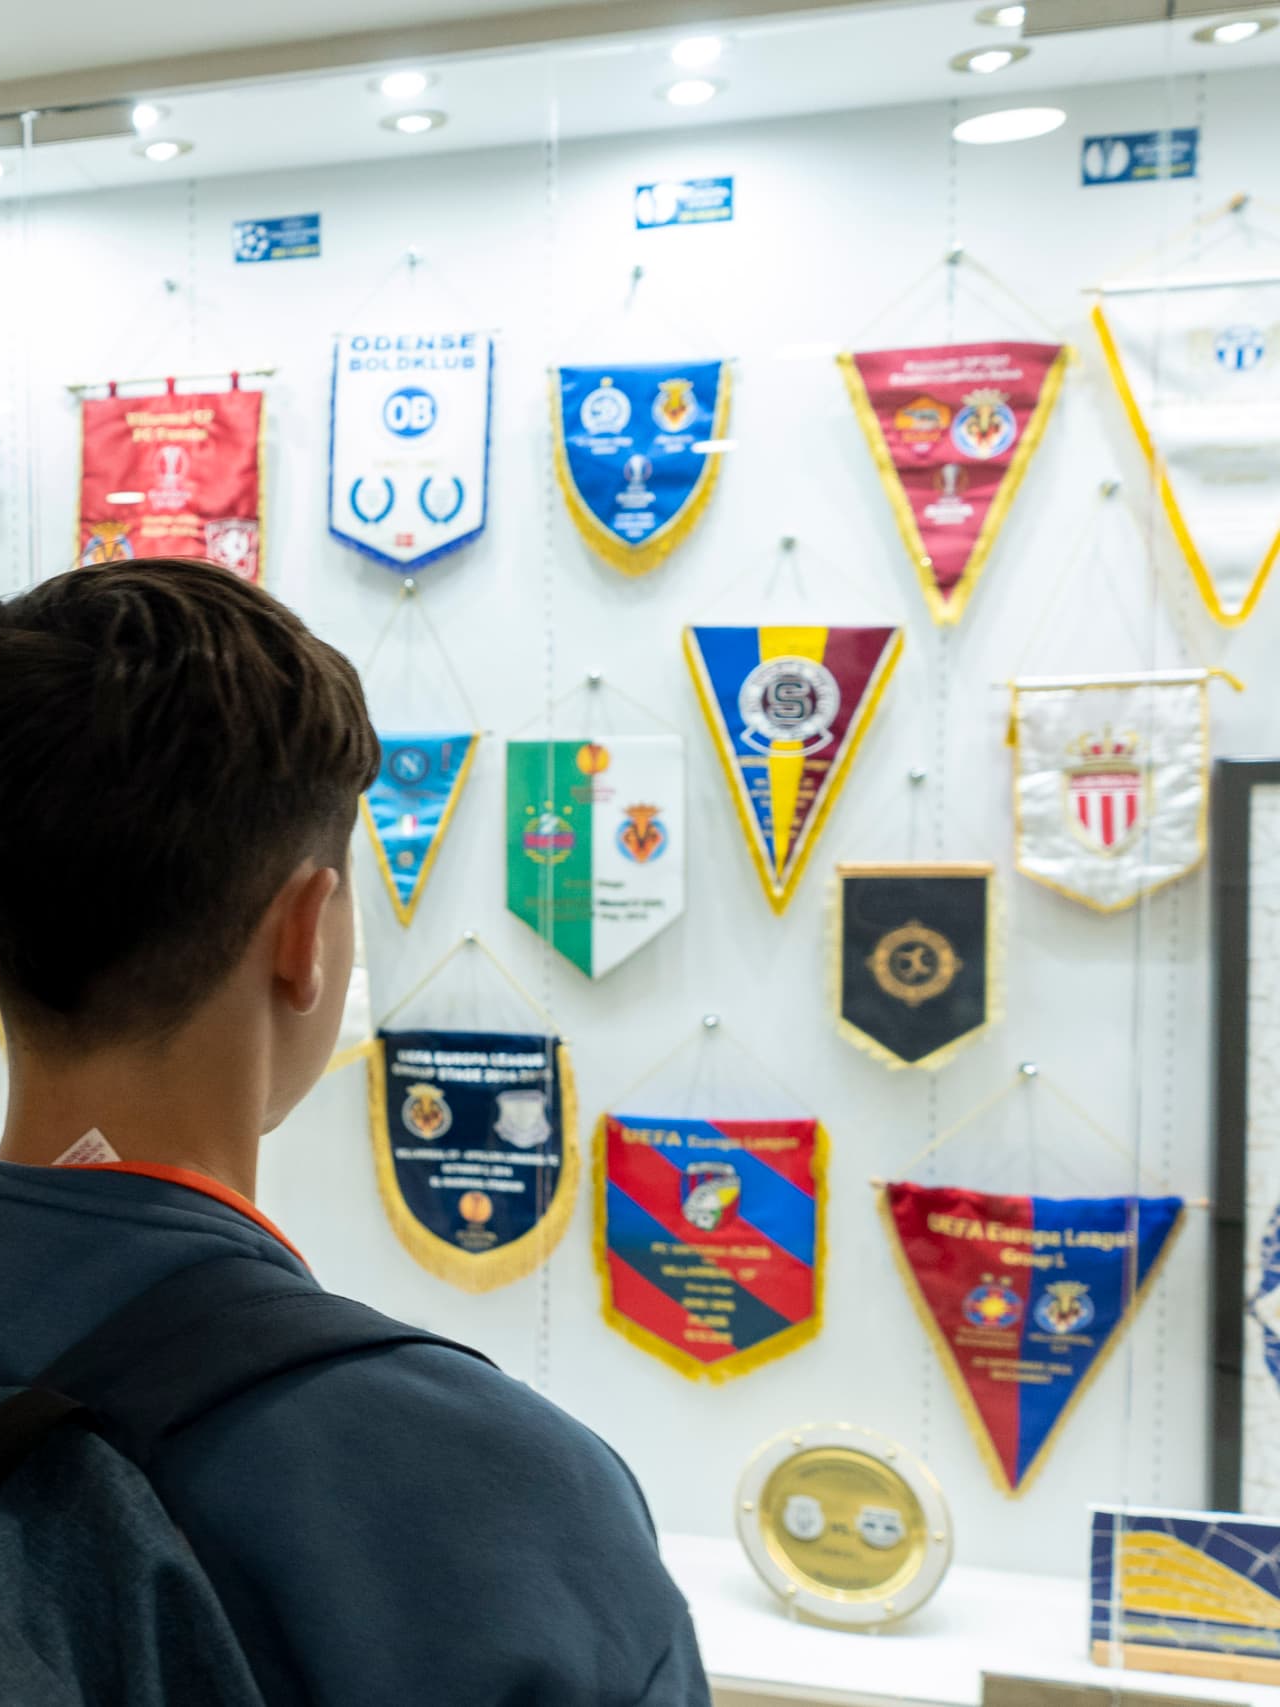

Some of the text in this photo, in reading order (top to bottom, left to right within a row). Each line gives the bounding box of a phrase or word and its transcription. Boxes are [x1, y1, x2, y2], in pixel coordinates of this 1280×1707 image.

[350, 333, 476, 351] ODENSE
[349, 356, 475, 371] BOLDKLUB
[386, 395, 433, 431] OB
[621, 1129, 682, 1146] UEFA
[927, 1213, 984, 1240] UEFA
[986, 1221, 1061, 1241] Europa
[1000, 1247, 1053, 1270] Group
